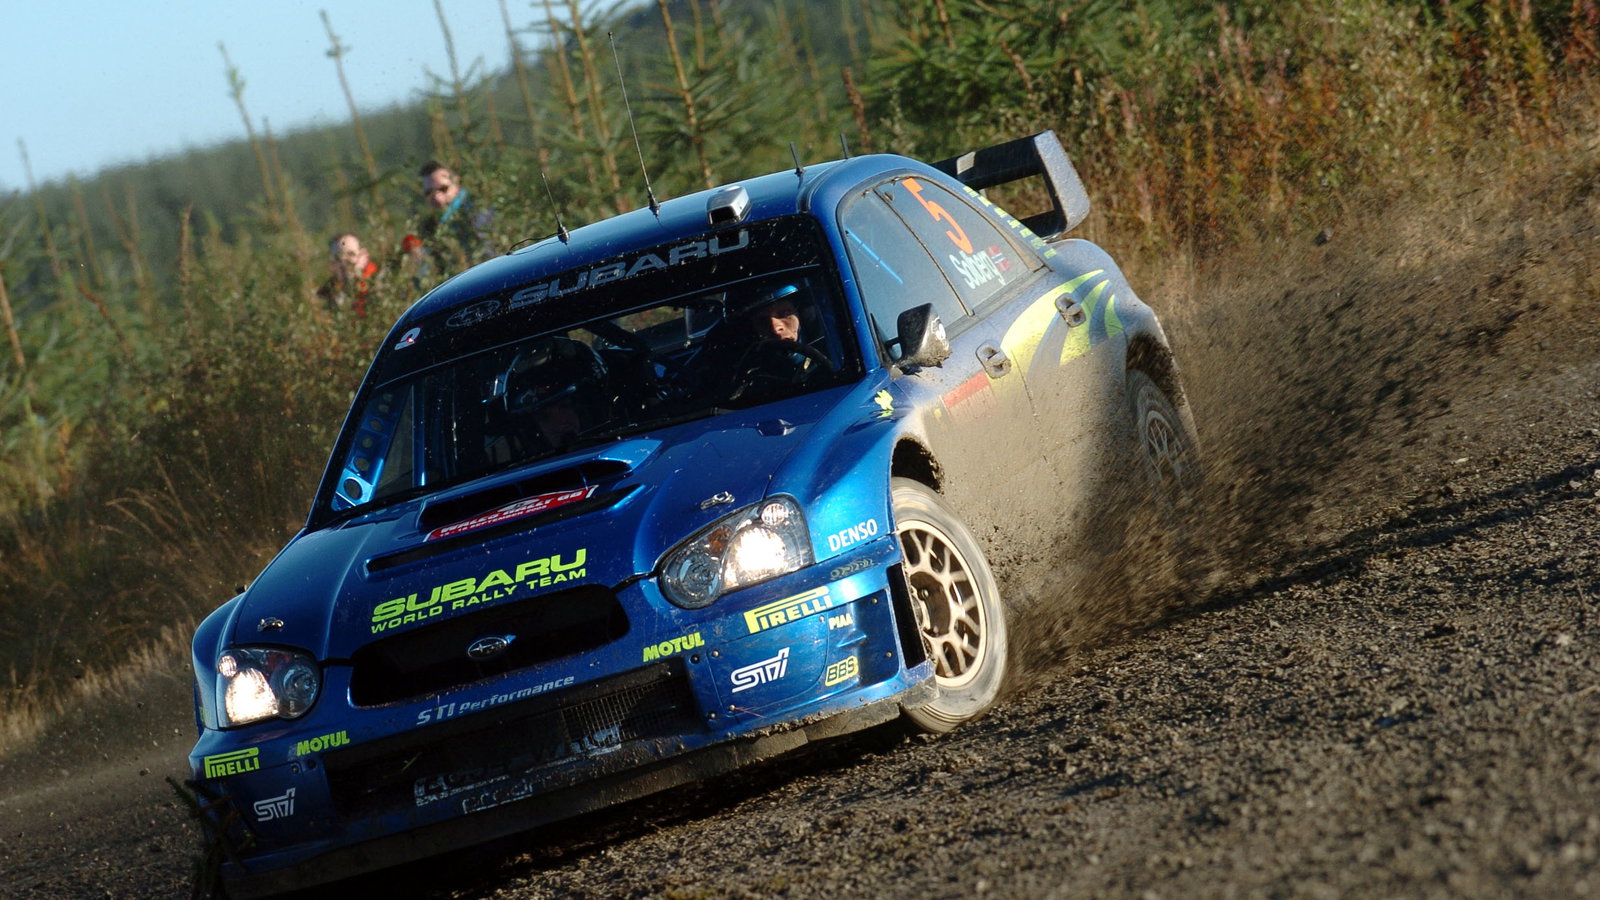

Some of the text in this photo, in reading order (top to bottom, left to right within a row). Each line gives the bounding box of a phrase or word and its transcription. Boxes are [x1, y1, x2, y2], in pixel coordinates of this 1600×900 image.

[901, 177, 974, 255] 5
[509, 229, 750, 310] SUBARU
[827, 518, 878, 552] DENSO
[371, 548, 587, 623] SUBARU
[371, 568, 586, 634] WORLD RALLY TEAM
[743, 585, 834, 634] PIRELLI
[828, 613, 853, 631] PIAA
[642, 631, 705, 663] MOTUL
[825, 656, 858, 685] BBS
[416, 675, 575, 726] STI Performance
[204, 747, 260, 779] PIRELLI
[296, 730, 351, 757] MOTUL
